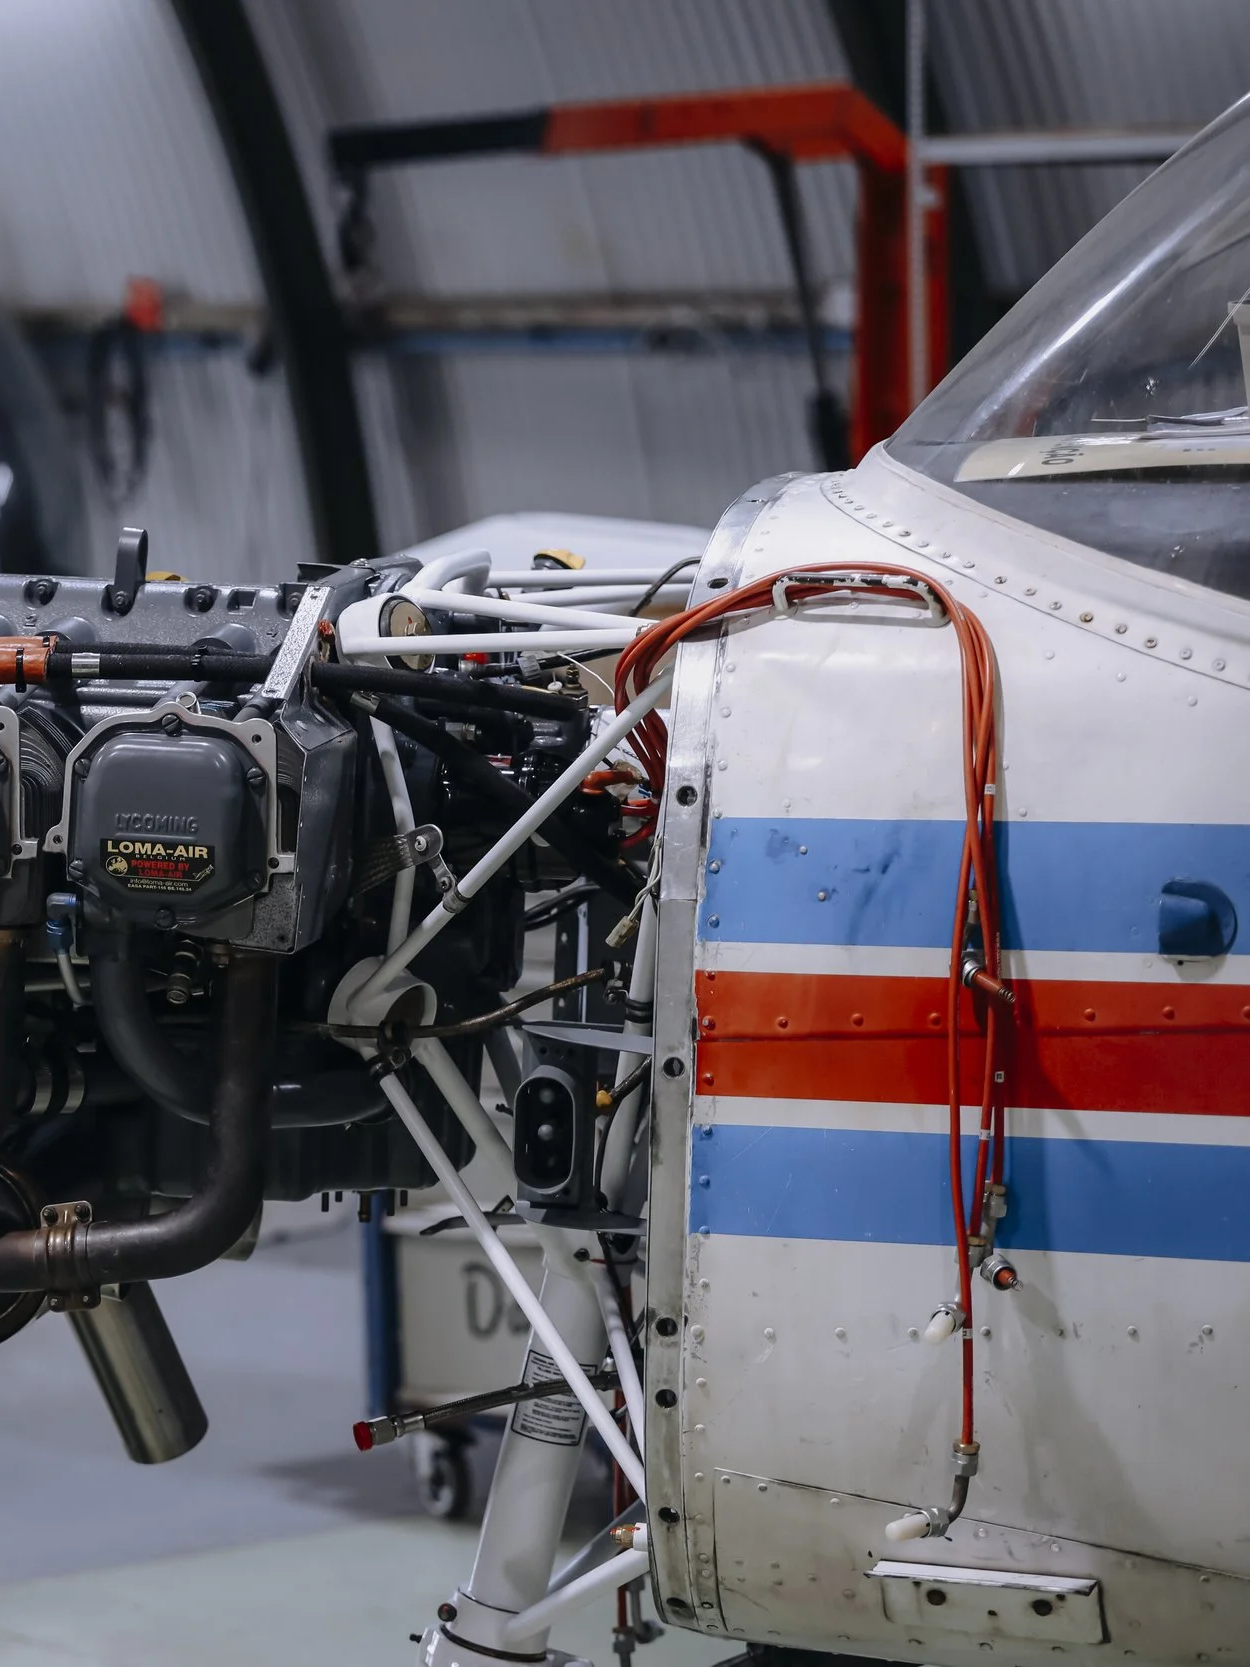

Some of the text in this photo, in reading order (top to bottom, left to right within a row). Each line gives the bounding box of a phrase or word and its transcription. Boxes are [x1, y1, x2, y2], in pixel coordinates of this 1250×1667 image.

[114, 813, 199, 834] LYCOMING
[107, 840, 208, 859] LOMA-AIR
[131, 859, 190, 871] POWERED BY
[139, 869, 183, 878] LOMA-AIR
[129, 878, 188, 887] info@loma-air.com
